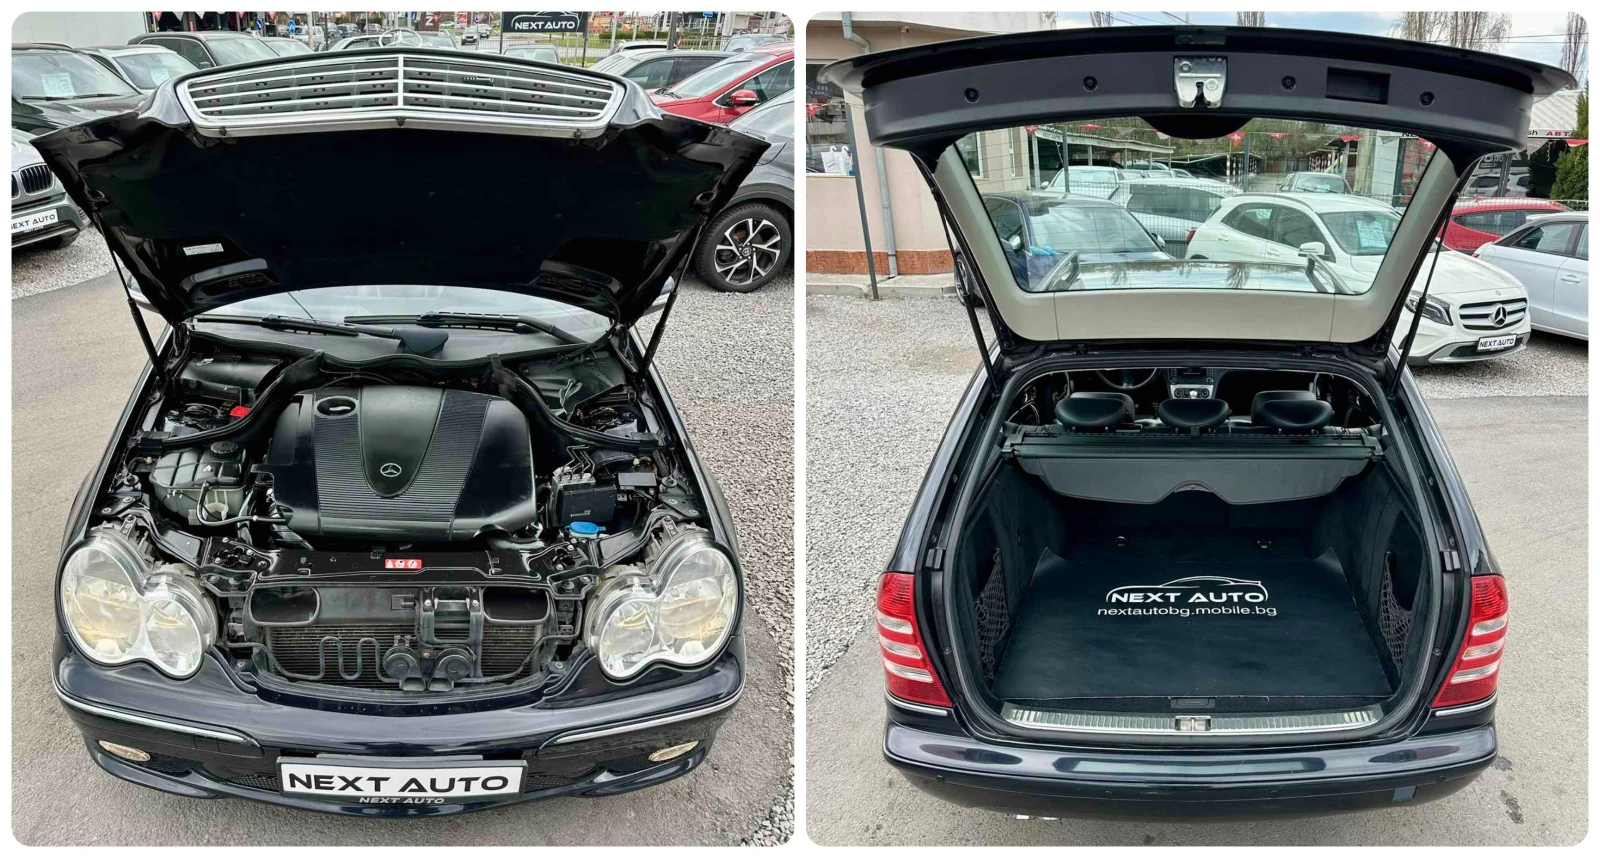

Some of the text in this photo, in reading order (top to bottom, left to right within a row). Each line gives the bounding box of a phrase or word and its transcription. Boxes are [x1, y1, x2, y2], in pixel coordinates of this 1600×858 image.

[515, 21, 575, 30] NEXT AUTO
[32, 214, 56, 225] AUTO
[1480, 338, 1515, 348] NEXT AUTO
[1111, 592, 1264, 603] NEXT AUTO
[1097, 605, 1278, 617] nextautobg.mobile.bg
[289, 773, 509, 793] NEXT AUTO
[359, 796, 400, 804] NEXT
